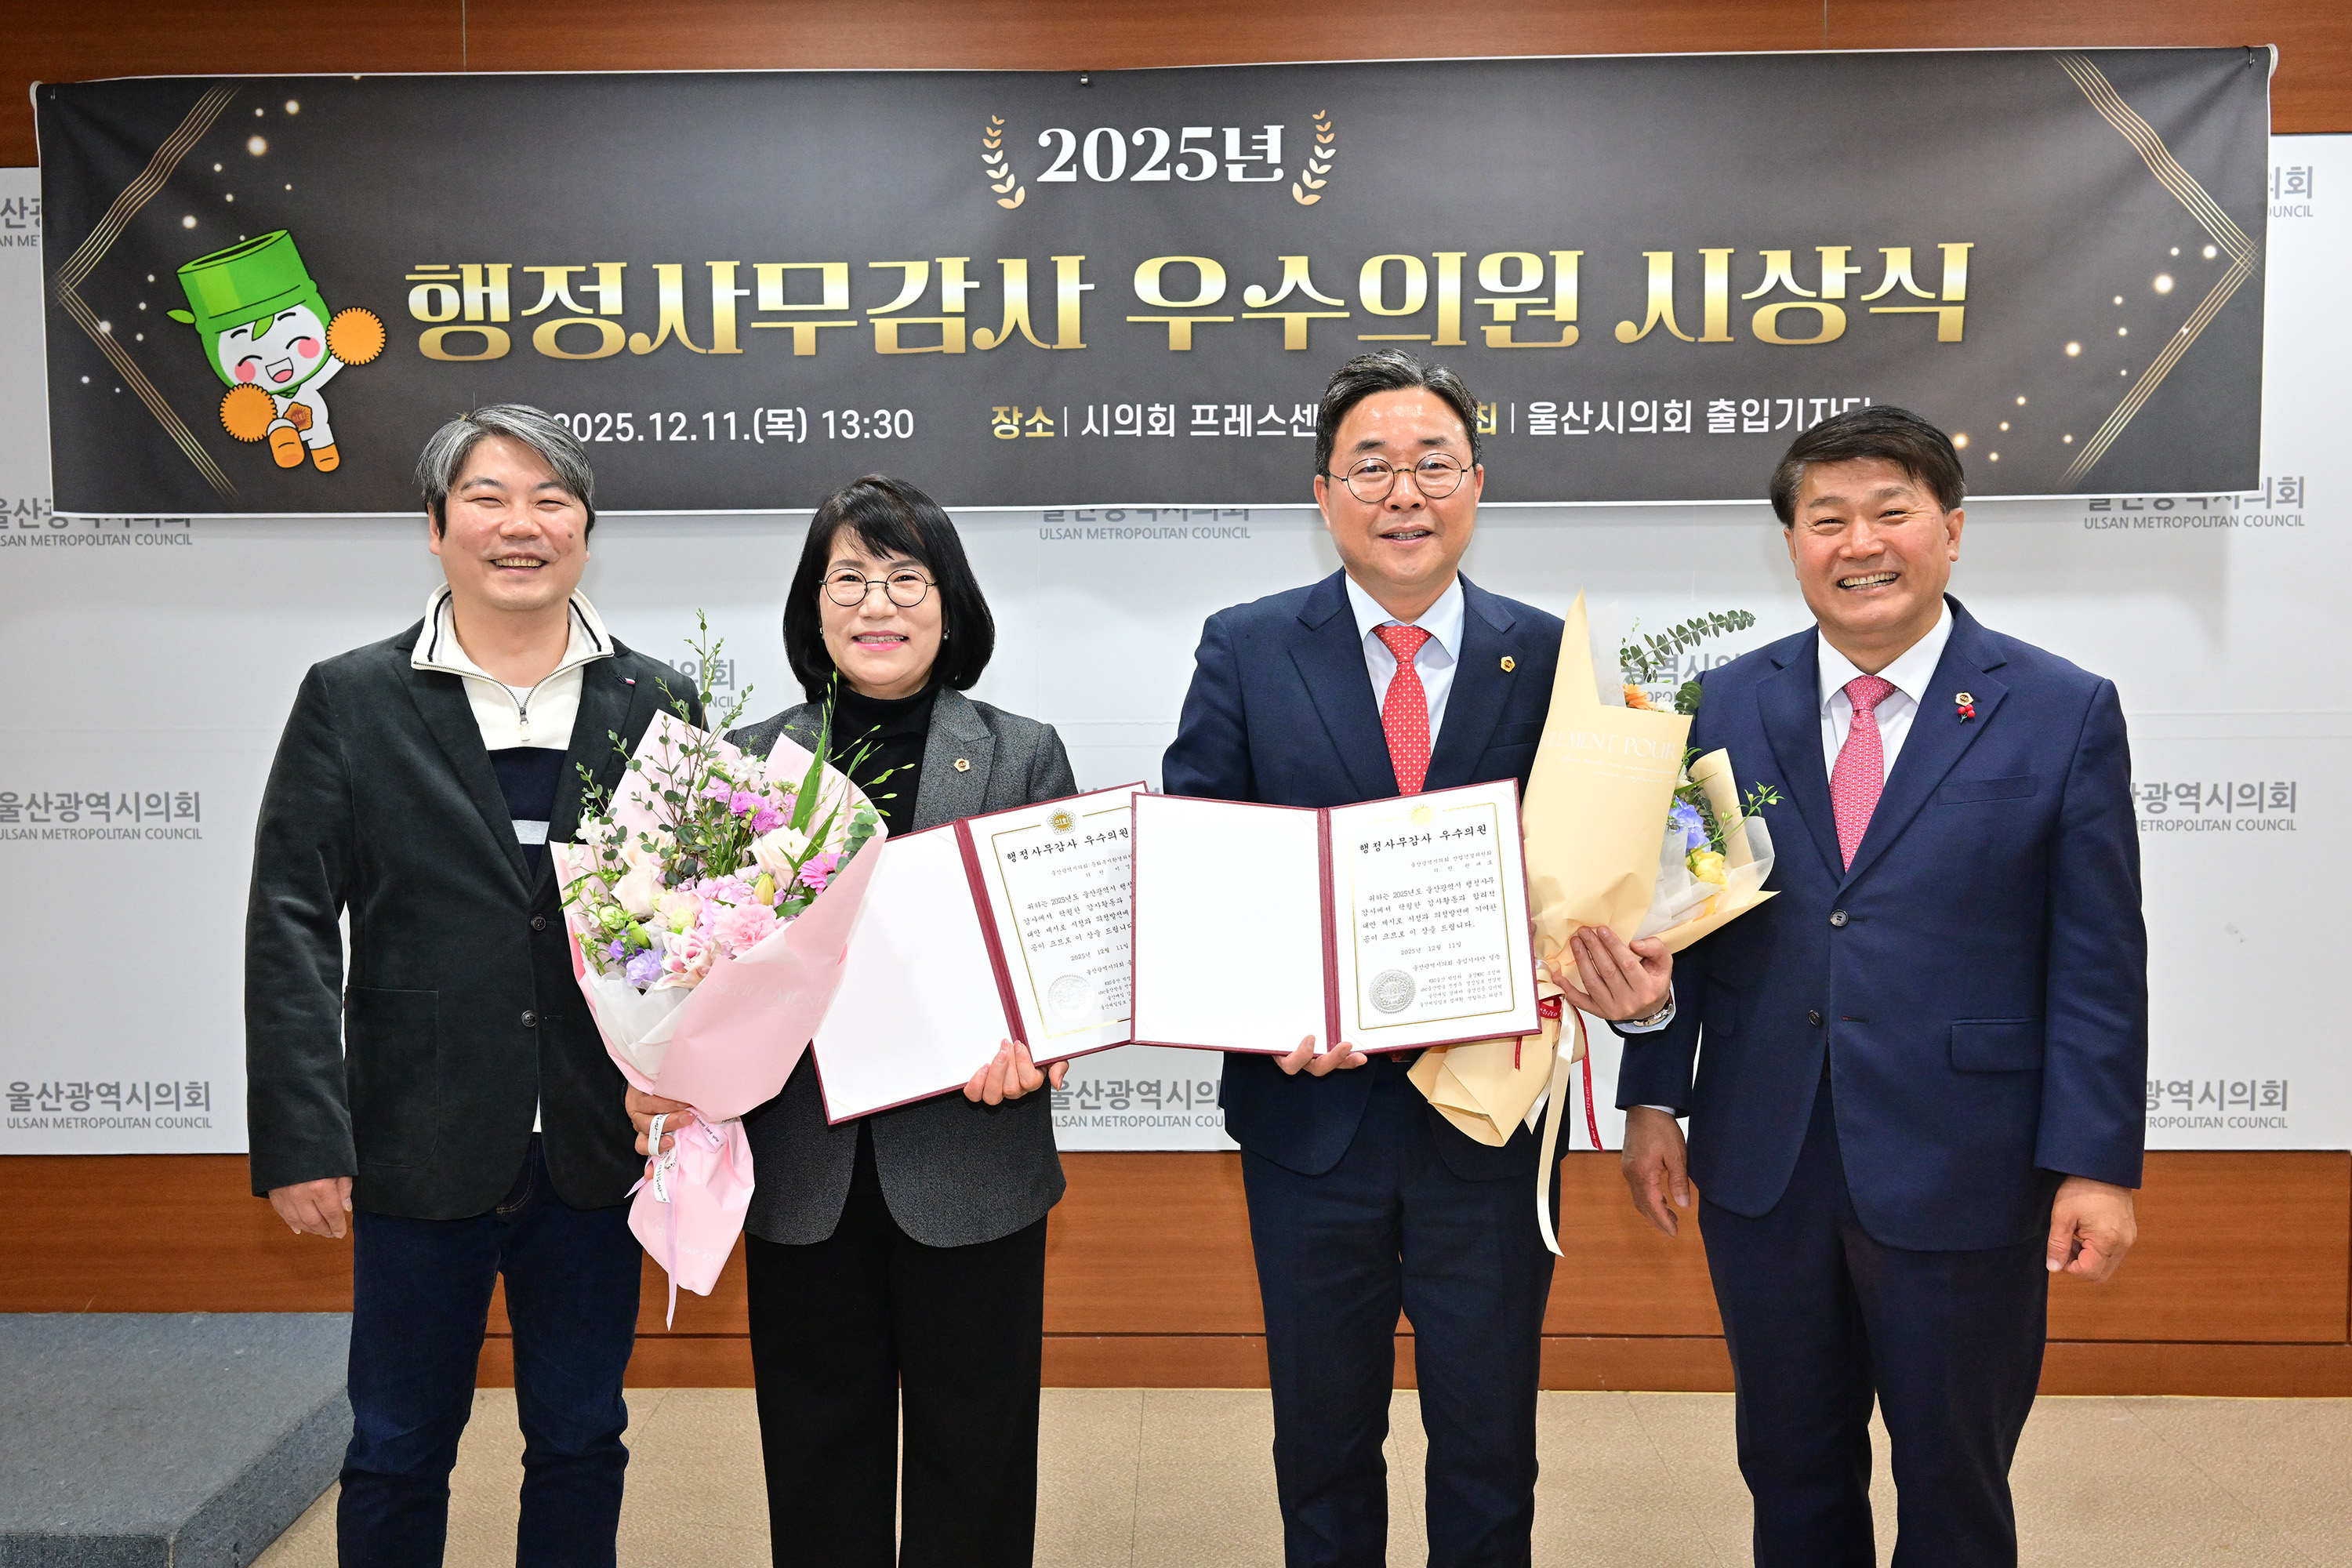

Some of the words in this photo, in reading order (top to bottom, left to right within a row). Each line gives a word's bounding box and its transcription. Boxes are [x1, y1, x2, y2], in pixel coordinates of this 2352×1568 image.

[1036, 125, 1285, 183] 2025년
[2270, 205, 2314, 218] UNCIL
[405, 256, 1095, 361] 행정사무감사
[1127, 250, 1584, 350] 우수의원
[1615, 242, 1974, 346] 시상식
[822, 408, 914, 439] 13:30
[992, 405, 1054, 440] 장소
[1082, 403, 1175, 437] 시의회
[1477, 401, 1496, 435] 최
[1527, 399, 1692, 436] 울산시의회
[2085, 517, 2129, 529] ULSAN
[2133, 515, 2239, 528] METROPOLITAN
[2244, 514, 2304, 528] COUNCIL
[0, 535, 27, 546] SAN
[31, 534, 130, 546] METROPOLITAN
[135, 533, 192, 546] COUNCIL
[1040, 528, 1082, 540] ULSAN
[1087, 527, 1188, 539] METROPOLITAN
[1192, 527, 1250, 539] COUNCIL
[708, 696, 736, 708] NCIL
[1624, 736, 1678, 761] POUR
[0, 792, 201, 823] 울산광역시의회
[42, 828, 141, 840] METROPOLITAN
[145, 828, 202, 840] COUNCIL
[2138, 819, 2231, 831] ETROPOLITAN
[2236, 818, 2296, 831] COUNCIL
[1007, 838, 1077, 862] 행정사무감사
[1084, 827, 1130, 845] 우수의원
[1359, 833, 1432, 854] 행정사무감사
[1439, 824, 1486, 840] 우수의원
[1027, 900, 1047, 910] 귀하는
[1051, 894, 1080, 906] 2025년도
[1083, 884, 1116, 898] 울산광역시
[1120, 881, 1132, 891] 행정
[1369, 893, 1390, 902] 귀하는
[1393, 887, 1421, 898] 2025년도
[1426, 881, 1461, 893] 울산광역시
[1466, 877, 1494, 887] 행정사무
[1024, 913, 1052, 925] 감사에서
[1087, 897, 1123, 911] 감사활동과
[1362, 906, 1391, 916] 감사에서
[1427, 895, 1466, 907] 감사활동과
[1382, 917, 1403, 927] 제시로
[1408, 913, 1429, 923] 시정과
[1435, 907, 1469, 919] 의정발전에
[1475, 903, 1497, 913] 기여한
[1027, 929, 1041, 938] 대안
[1046, 924, 1066, 934] 제시로
[1071, 917, 1091, 927] 시정과
[1096, 909, 1130, 922] 의정발전에
[1363, 934, 1377, 943] 공이
[1382, 931, 1405, 940] 크므로
[1421, 925, 1436, 935] 상을
[1441, 920, 1475, 931] 드립니다.
[1031, 942, 1045, 952] 공이
[1050, 938, 1072, 948] 크므로
[1087, 929, 1101, 939] 상을
[1400, 947, 1421, 956] 2025년
[1070, 952, 1091, 961] 2025년
[1086, 961, 1124, 975] 울산광역시의회
[1413, 960, 1453, 971] 울산광역시의회
[5, 1081, 210, 1112] 울산광역시의회
[1051, 1080, 1221, 1110] 울산광역시의
[7, 1117, 49, 1129] ULSAN
[53, 1117, 151, 1129] METROPOLITAN
[155, 1117, 212, 1128] COUNCIL
[1052, 1116, 1087, 1127] LSAN
[1092, 1116, 1191, 1127] METROPOLITAN
[2227, 1116, 2288, 1128] COUNCIL
